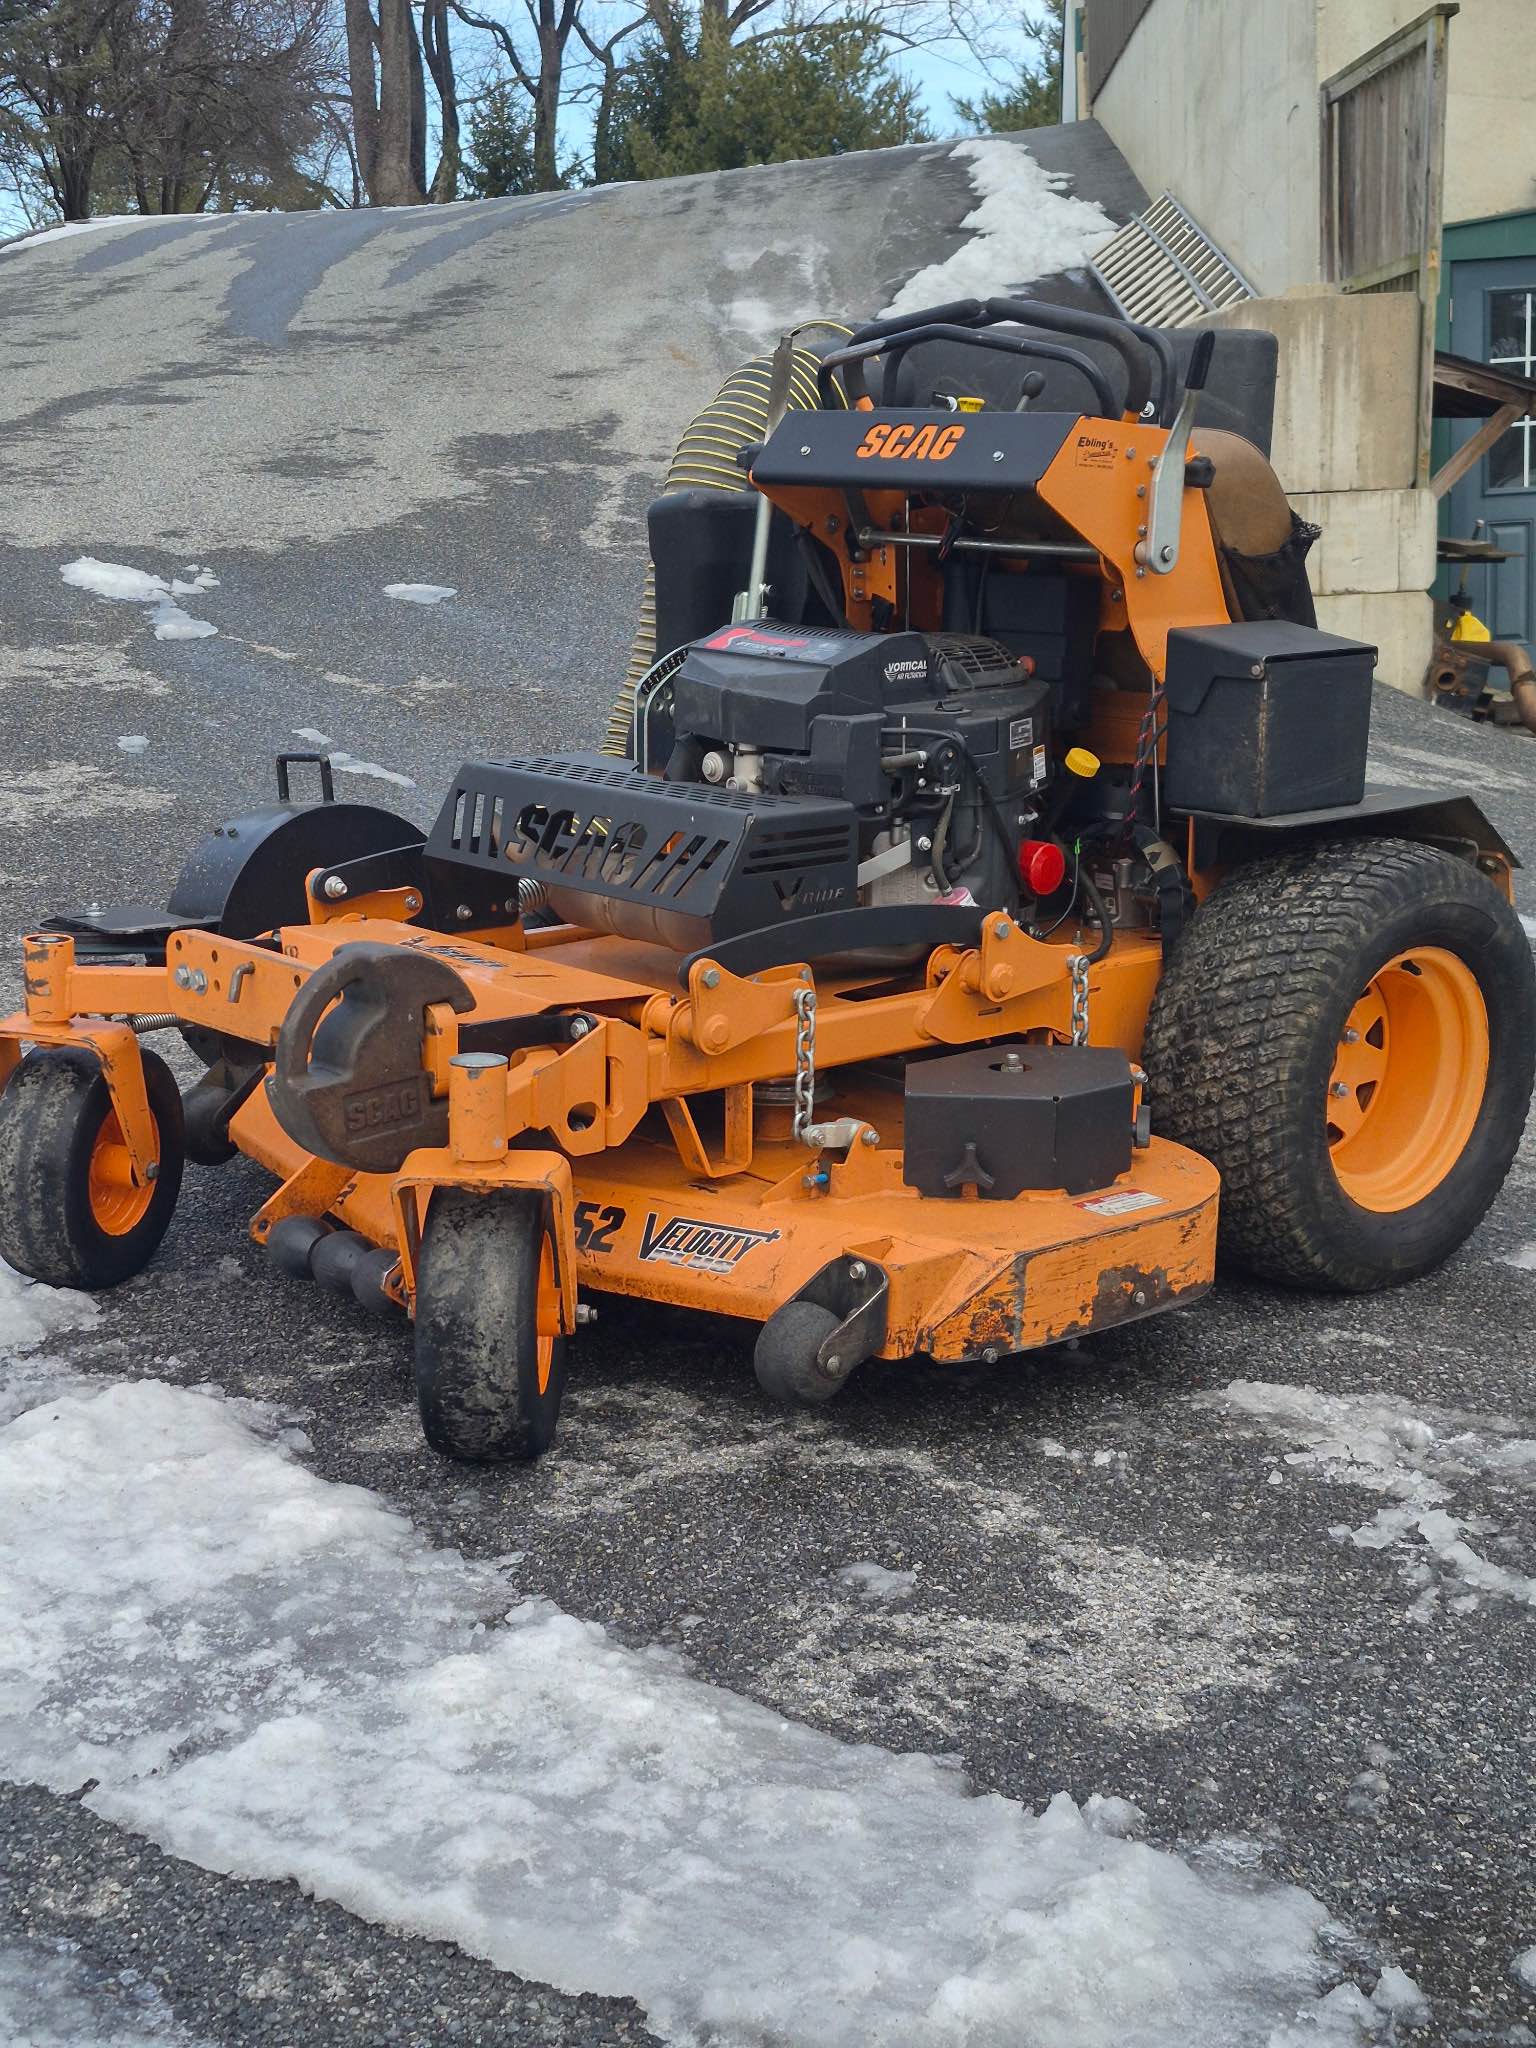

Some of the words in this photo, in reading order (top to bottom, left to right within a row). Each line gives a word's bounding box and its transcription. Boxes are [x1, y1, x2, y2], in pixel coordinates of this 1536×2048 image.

[856, 423, 966, 460] SCAG
[1078, 436, 1114, 450] Ebling's
[888, 660, 927, 671] VORTICAL
[504, 803, 648, 886] SCAG
[347, 1088, 418, 1131] SCAG
[574, 1201, 627, 1253] 52
